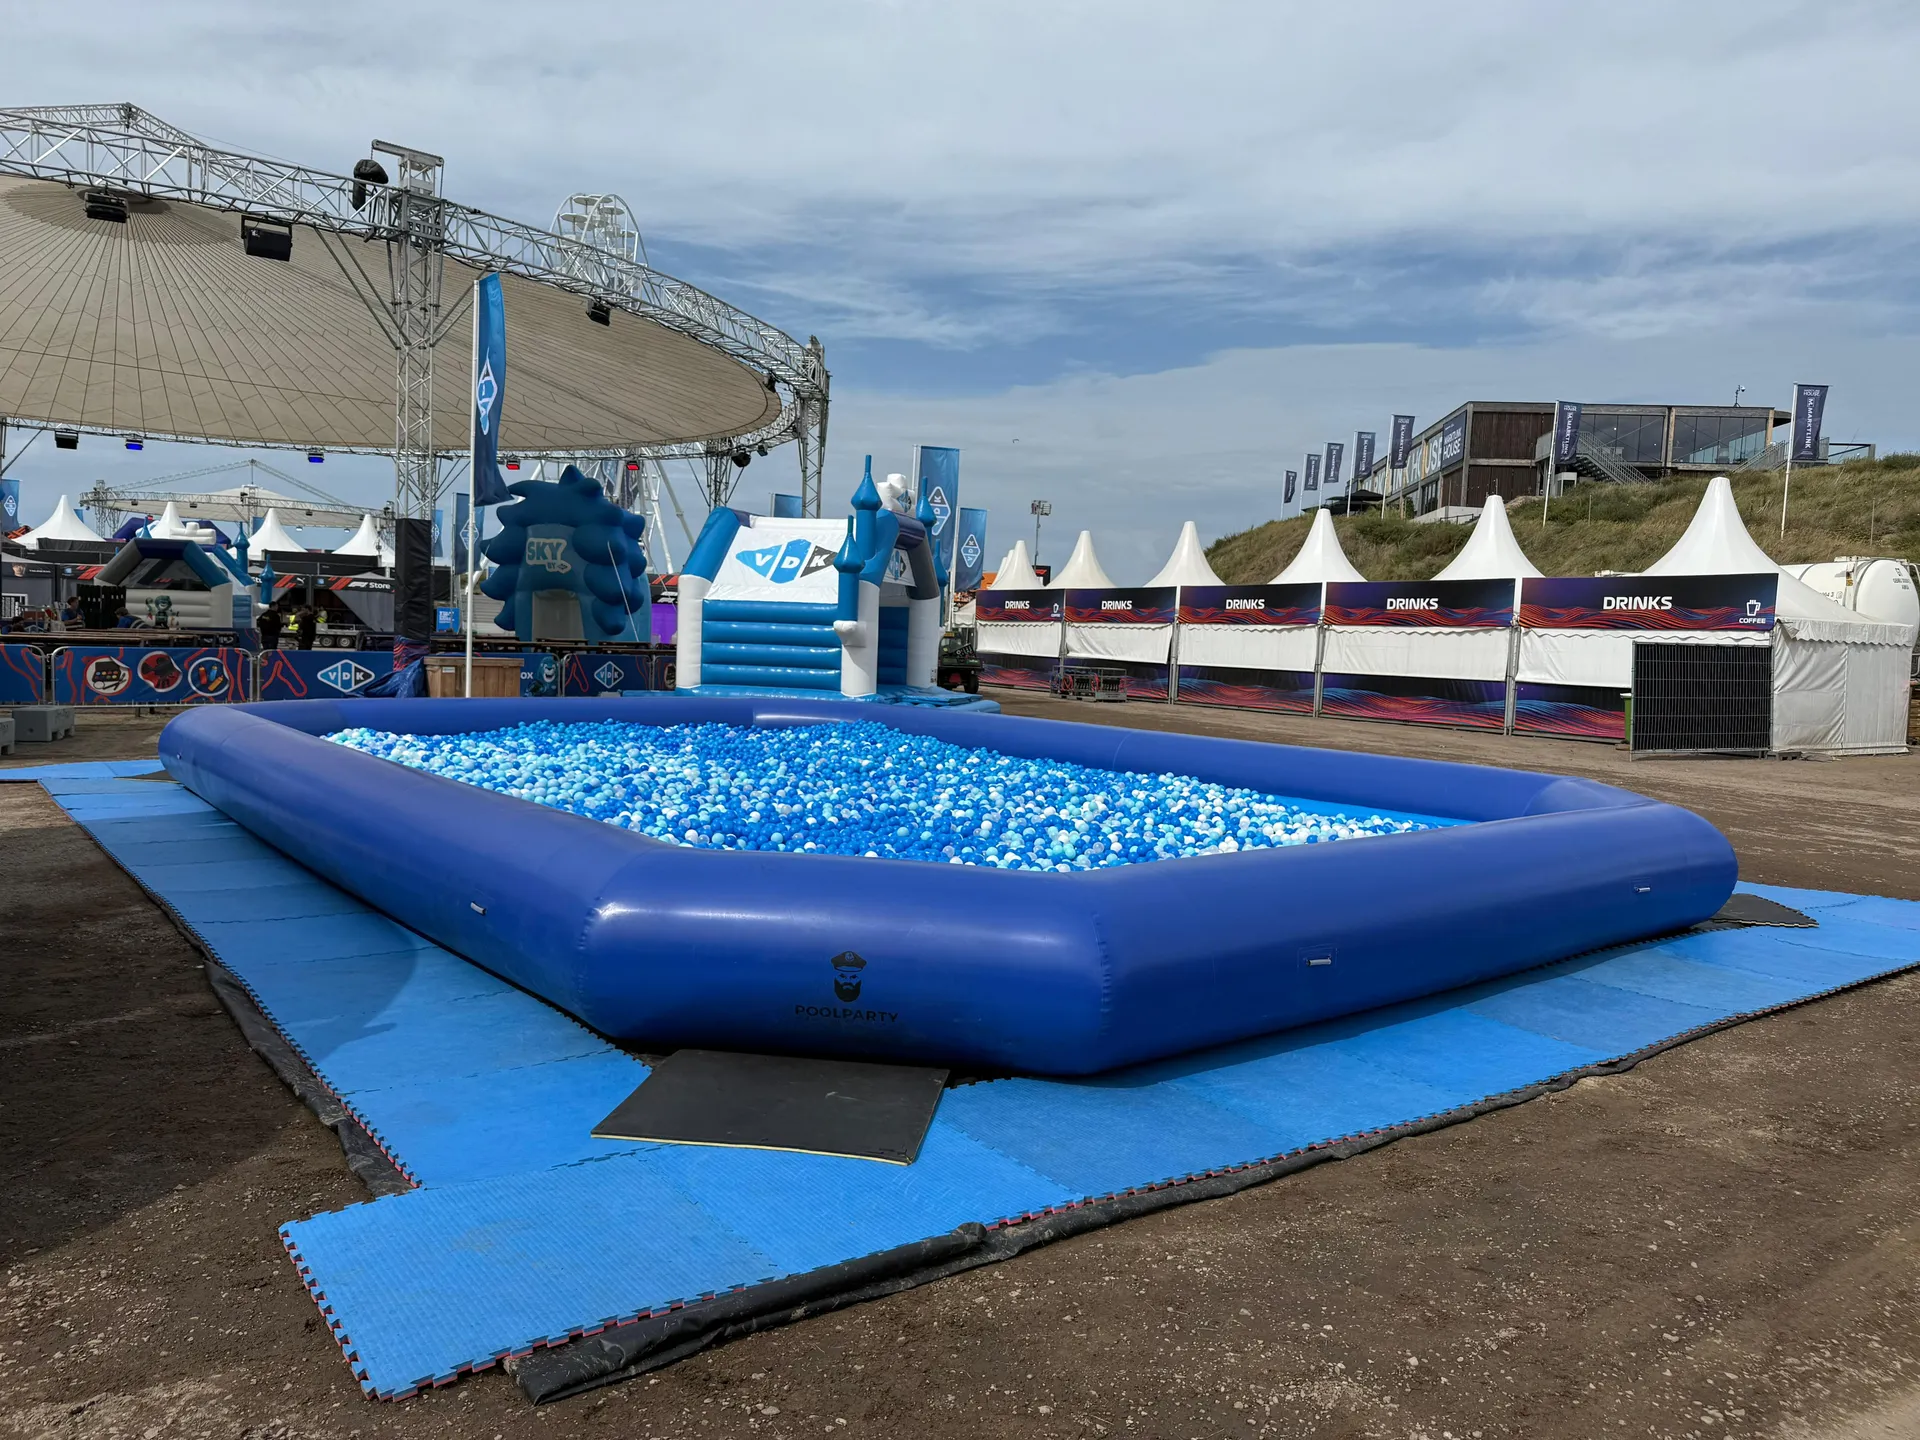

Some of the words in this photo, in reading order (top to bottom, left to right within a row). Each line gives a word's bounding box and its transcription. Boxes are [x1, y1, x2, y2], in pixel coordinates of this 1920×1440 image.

[1805, 407, 1813, 448] MARKTLINK
[1443, 437, 1462, 461] HOUSE
[528, 541, 563, 560] SKY
[755, 552, 830, 570] VDK
[369, 582, 391, 590] Store
[1004, 600, 1030, 609] DRINKS
[1101, 600, 1132, 610] DRINKS
[1225, 599, 1265, 610] DRINKS
[1386, 597, 1439, 610] DRINKS
[1603, 596, 1673, 610] DRINKS
[328, 671, 365, 680] VDK
[600, 671, 619, 679] VDK
[796, 1005, 898, 1022] POOLPARTY
